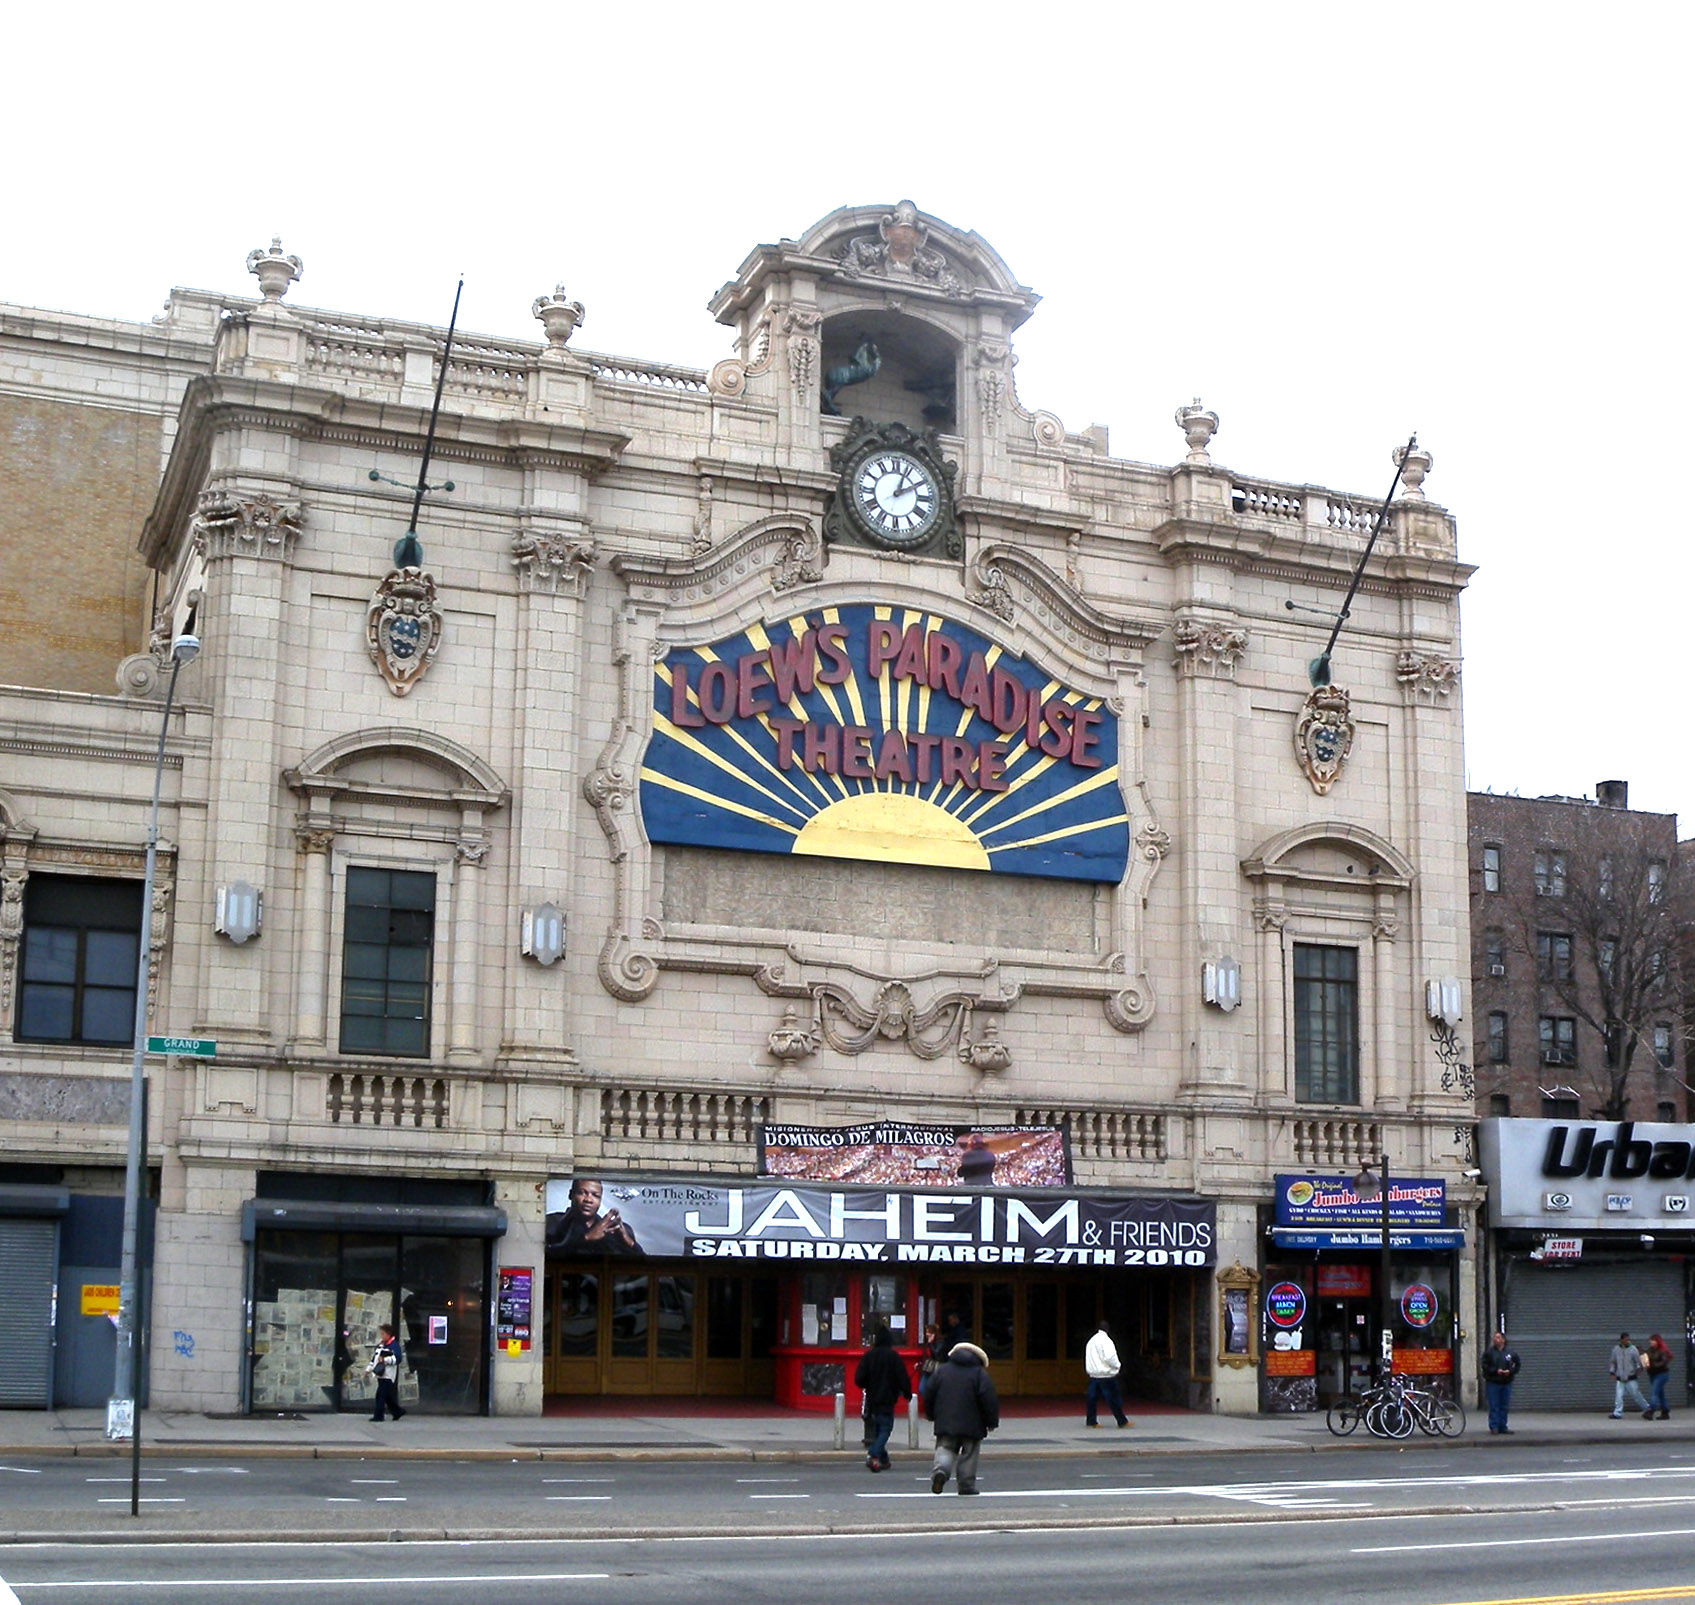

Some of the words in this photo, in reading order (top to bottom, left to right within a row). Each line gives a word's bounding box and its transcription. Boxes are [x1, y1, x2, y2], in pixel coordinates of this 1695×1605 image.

[868, 620, 1104, 769] PARADISE
[769, 716, 1010, 793] THEATRE
[163, 1038, 200, 1050] GRAND
[764, 1132, 845, 1147] DOMINGO
[849, 1131, 872, 1145] DE
[875, 1131, 956, 1146] MILAGROS
[641, 1187, 659, 1199] On
[661, 1187, 684, 1200] The
[686, 1189, 720, 1201] Rocks
[1312, 1188, 1360, 1208] Jumbo
[1361, 1185, 1443, 1204] burgers
[684, 1187, 1080, 1245] JAHEIM
[1082, 1219, 1103, 1246] &
[1110, 1220, 1212, 1248] FRIENDS
[1330, 1233, 1359, 1244] Jumbo
[1361, 1234, 1412, 1246] Hamrgers
[1551, 1241, 1577, 1250] STORE
[899, 1244, 1025, 1264] MARCH
[1033, 1247, 1116, 1265] 27TH
[1123, 1249, 1207, 1267] 2010
